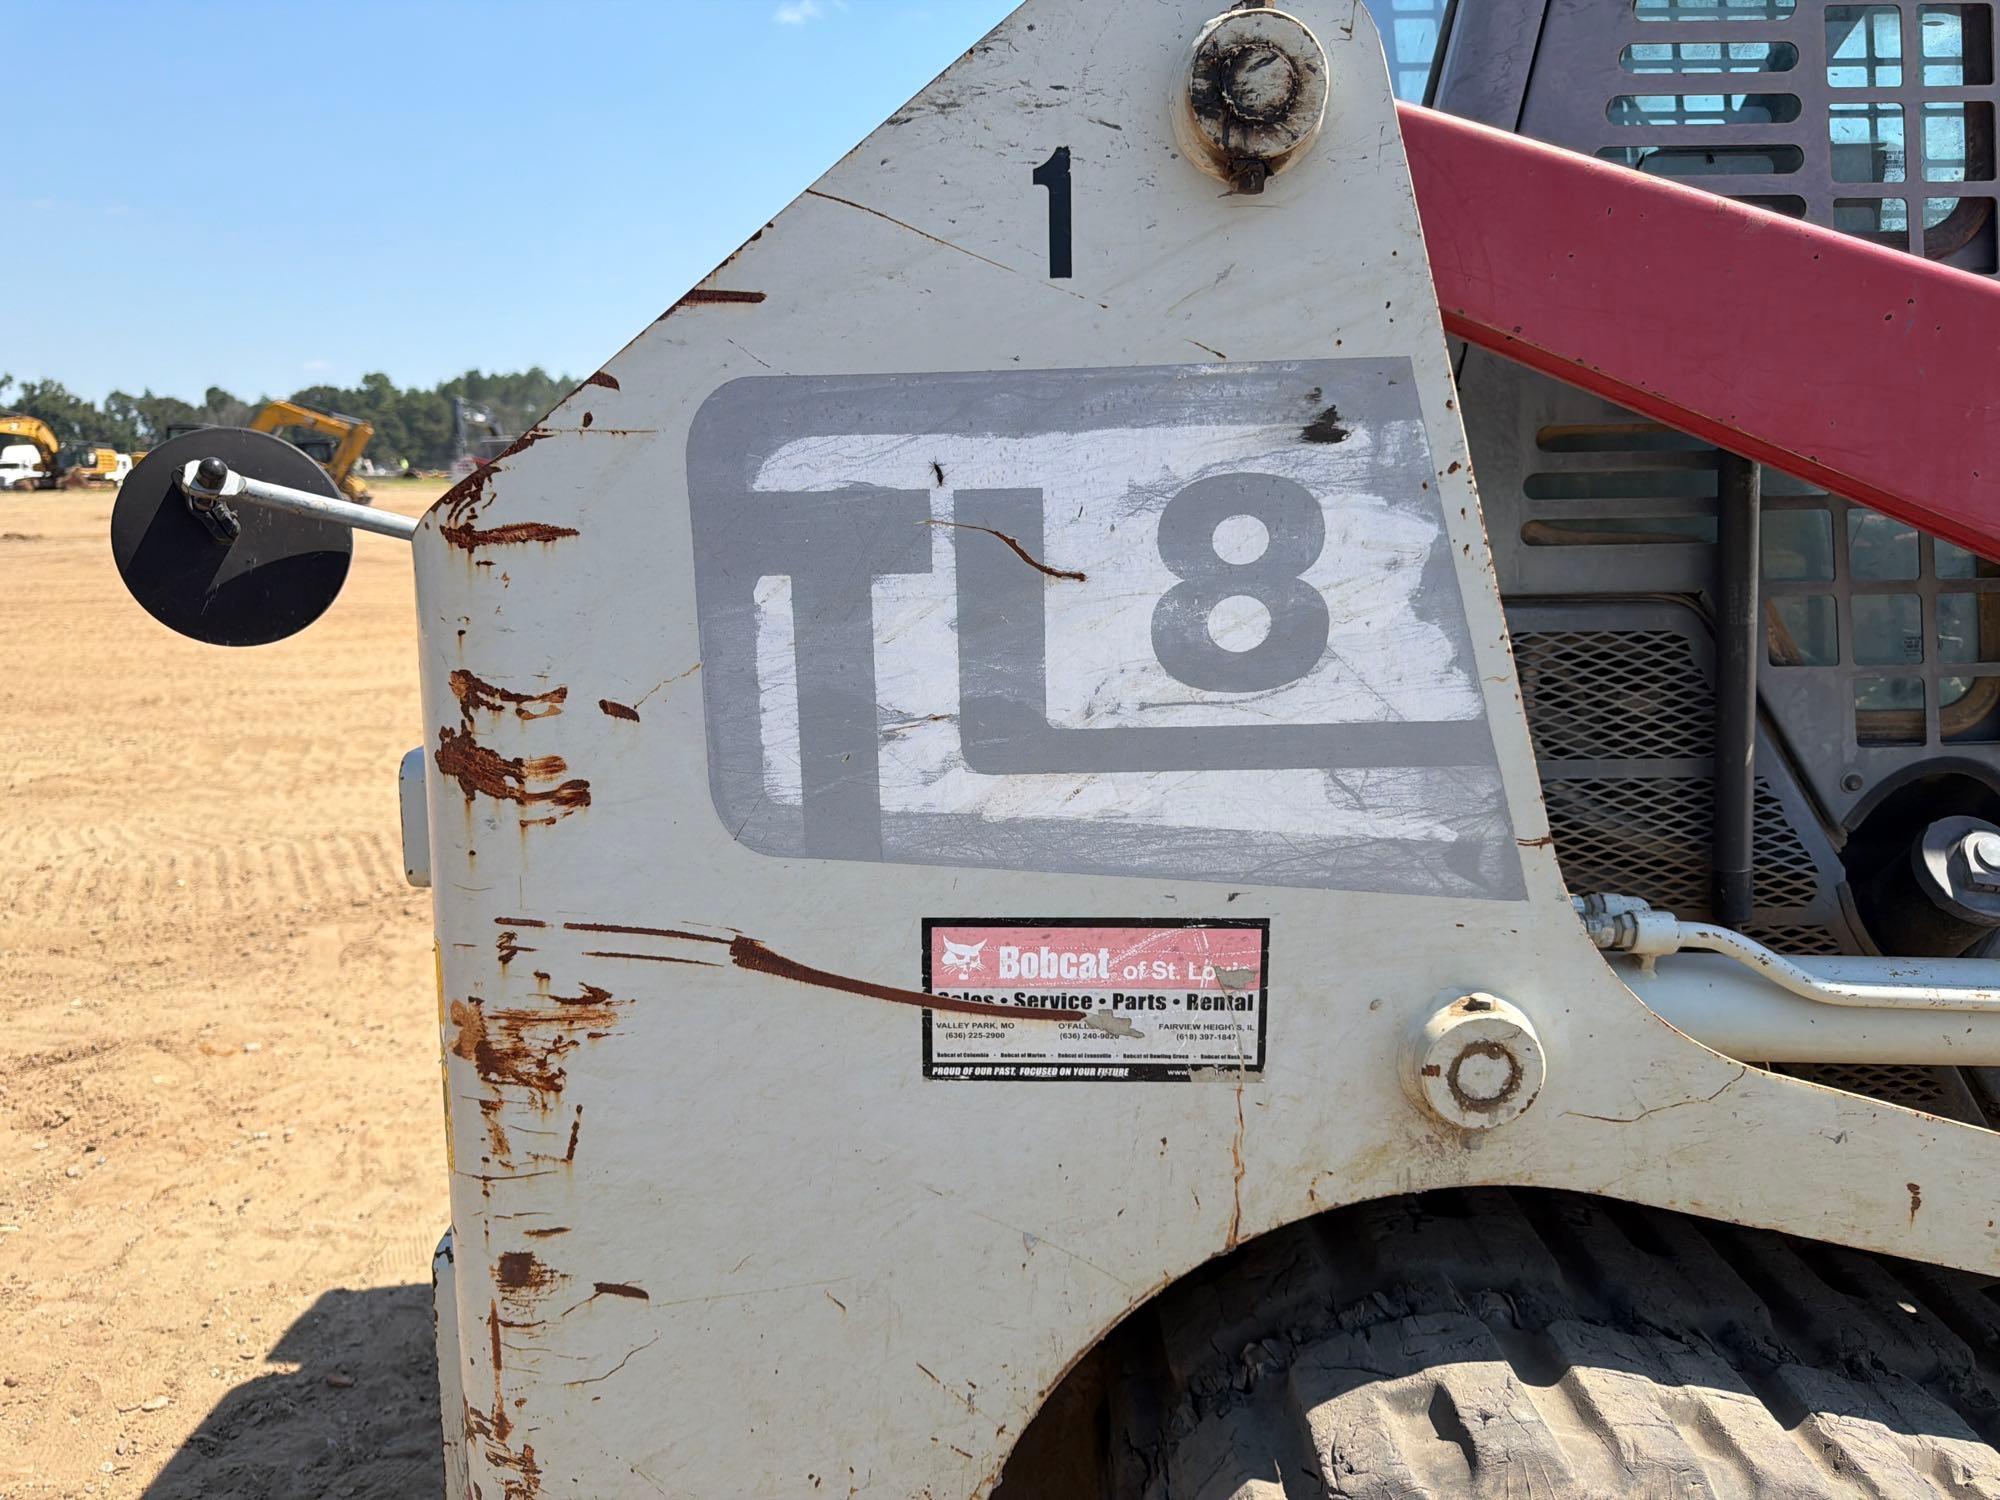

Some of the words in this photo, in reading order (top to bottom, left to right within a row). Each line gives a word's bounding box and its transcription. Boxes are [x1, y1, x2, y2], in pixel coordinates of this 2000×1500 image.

[1033, 146, 1072, 278] 1
[738, 470, 1486, 857] TL8
[999, 945, 1110, 980] Bobcat
[1123, 961, 1147, 979] of
[1151, 960, 1181, 980] St.
[1013, 991, 1093, 1010] Service
[1112, 993, 1167, 1010] Parts
[1186, 993, 1254, 1011] Rental
[972, 1022, 999, 1030] PARK,
[1158, 1023, 1201, 1031] FAIRVIEW
[945, 1032, 966, 1040] (636)
[1060, 1032, 1081, 1041] (636)
[1176, 1033, 1197, 1041] (618)
[1199, 1033, 1236, 1041] 397-1847
[932, 1067, 960, 1076] PROUD
[962, 1067, 973, 1076] OF
[974, 1067, 992, 1076] OUR
[993, 1067, 1016, 1077] PAST.
[1019, 1067, 1058, 1076] FOCUSED
[1059, 1068, 1072, 1076] ON
[1073, 1068, 1096, 1076] YOUR
[1097, 1068, 1129, 1077] FUTURE
